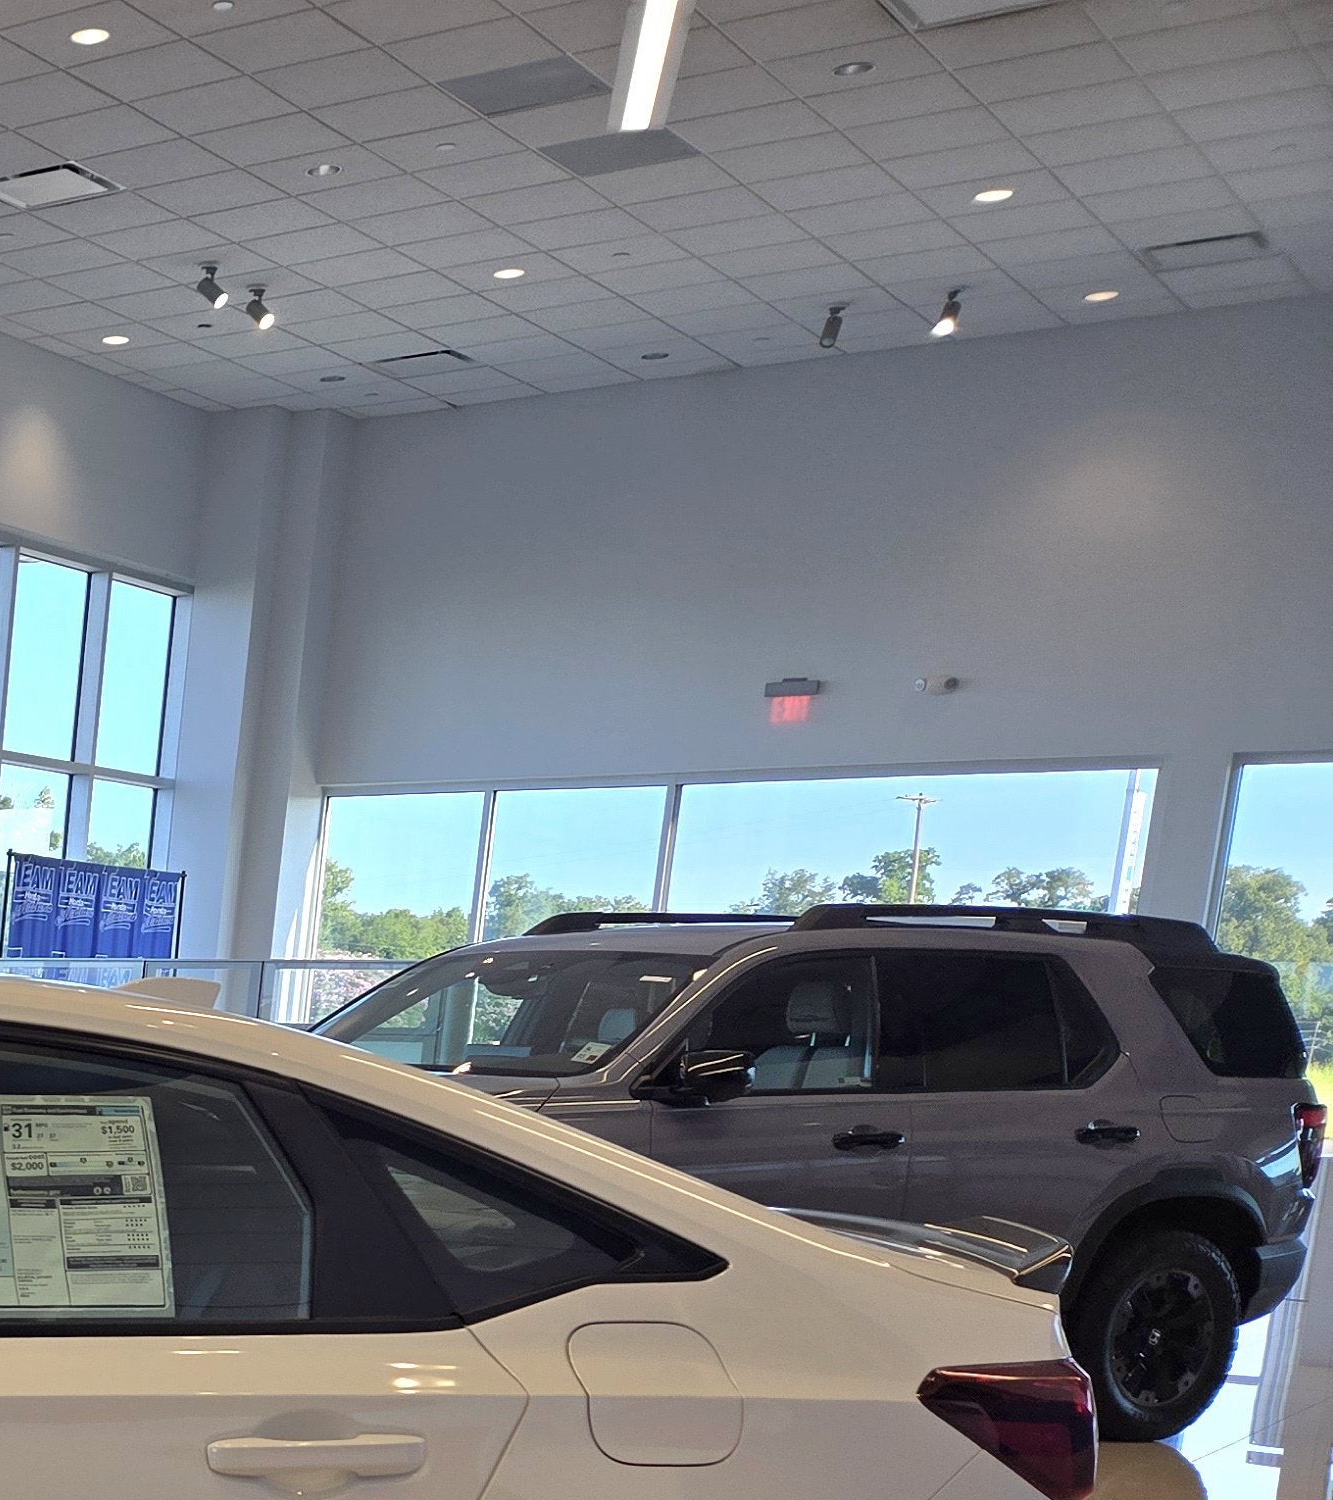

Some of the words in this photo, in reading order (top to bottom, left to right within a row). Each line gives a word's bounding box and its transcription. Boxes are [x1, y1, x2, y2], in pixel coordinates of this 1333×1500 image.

[11, 1122, 33, 1139] 31
[101, 1124, 135, 1135] $1,500
[10, 1161, 45, 1171] $2,000
